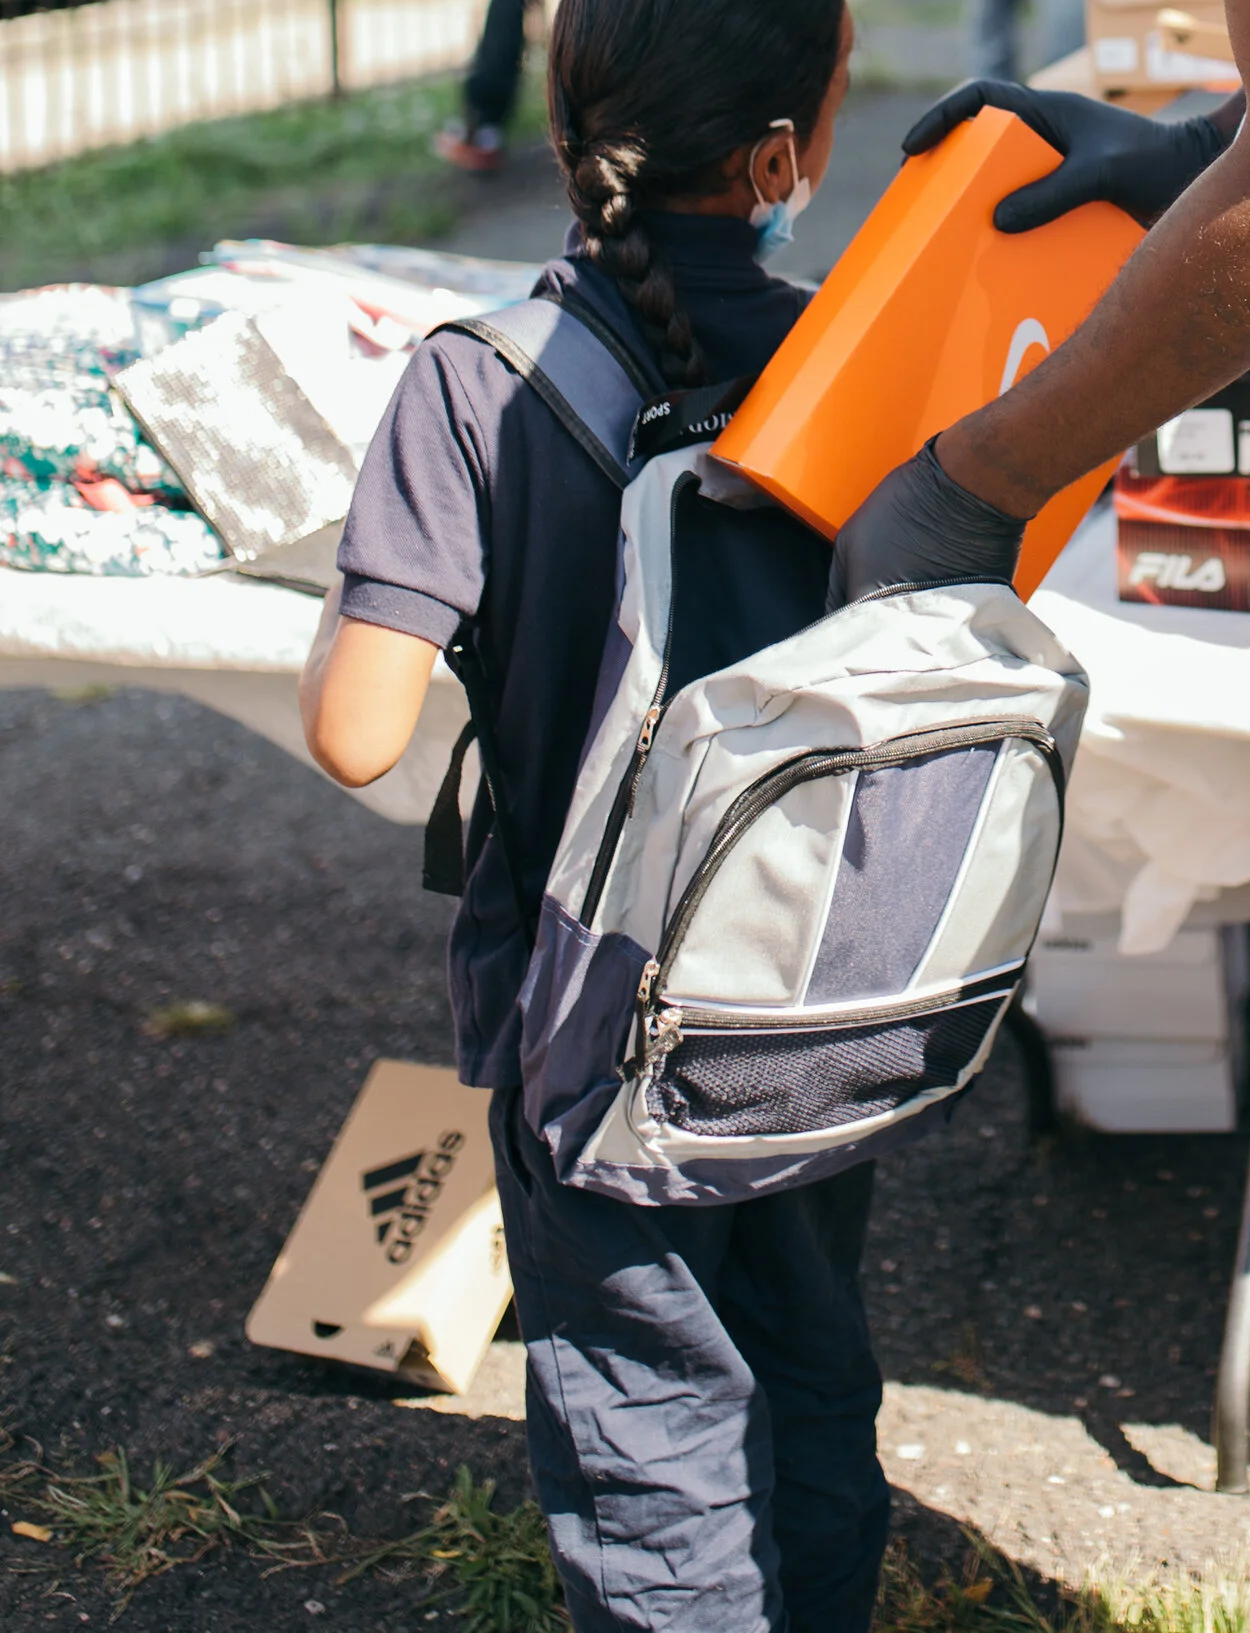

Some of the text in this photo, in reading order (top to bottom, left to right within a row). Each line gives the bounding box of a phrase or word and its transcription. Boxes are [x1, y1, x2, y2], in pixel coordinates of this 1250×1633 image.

[641, 401, 671, 425] SPORT
[1128, 551, 1226, 593] FILA
[386, 1129, 466, 1265] adidas
